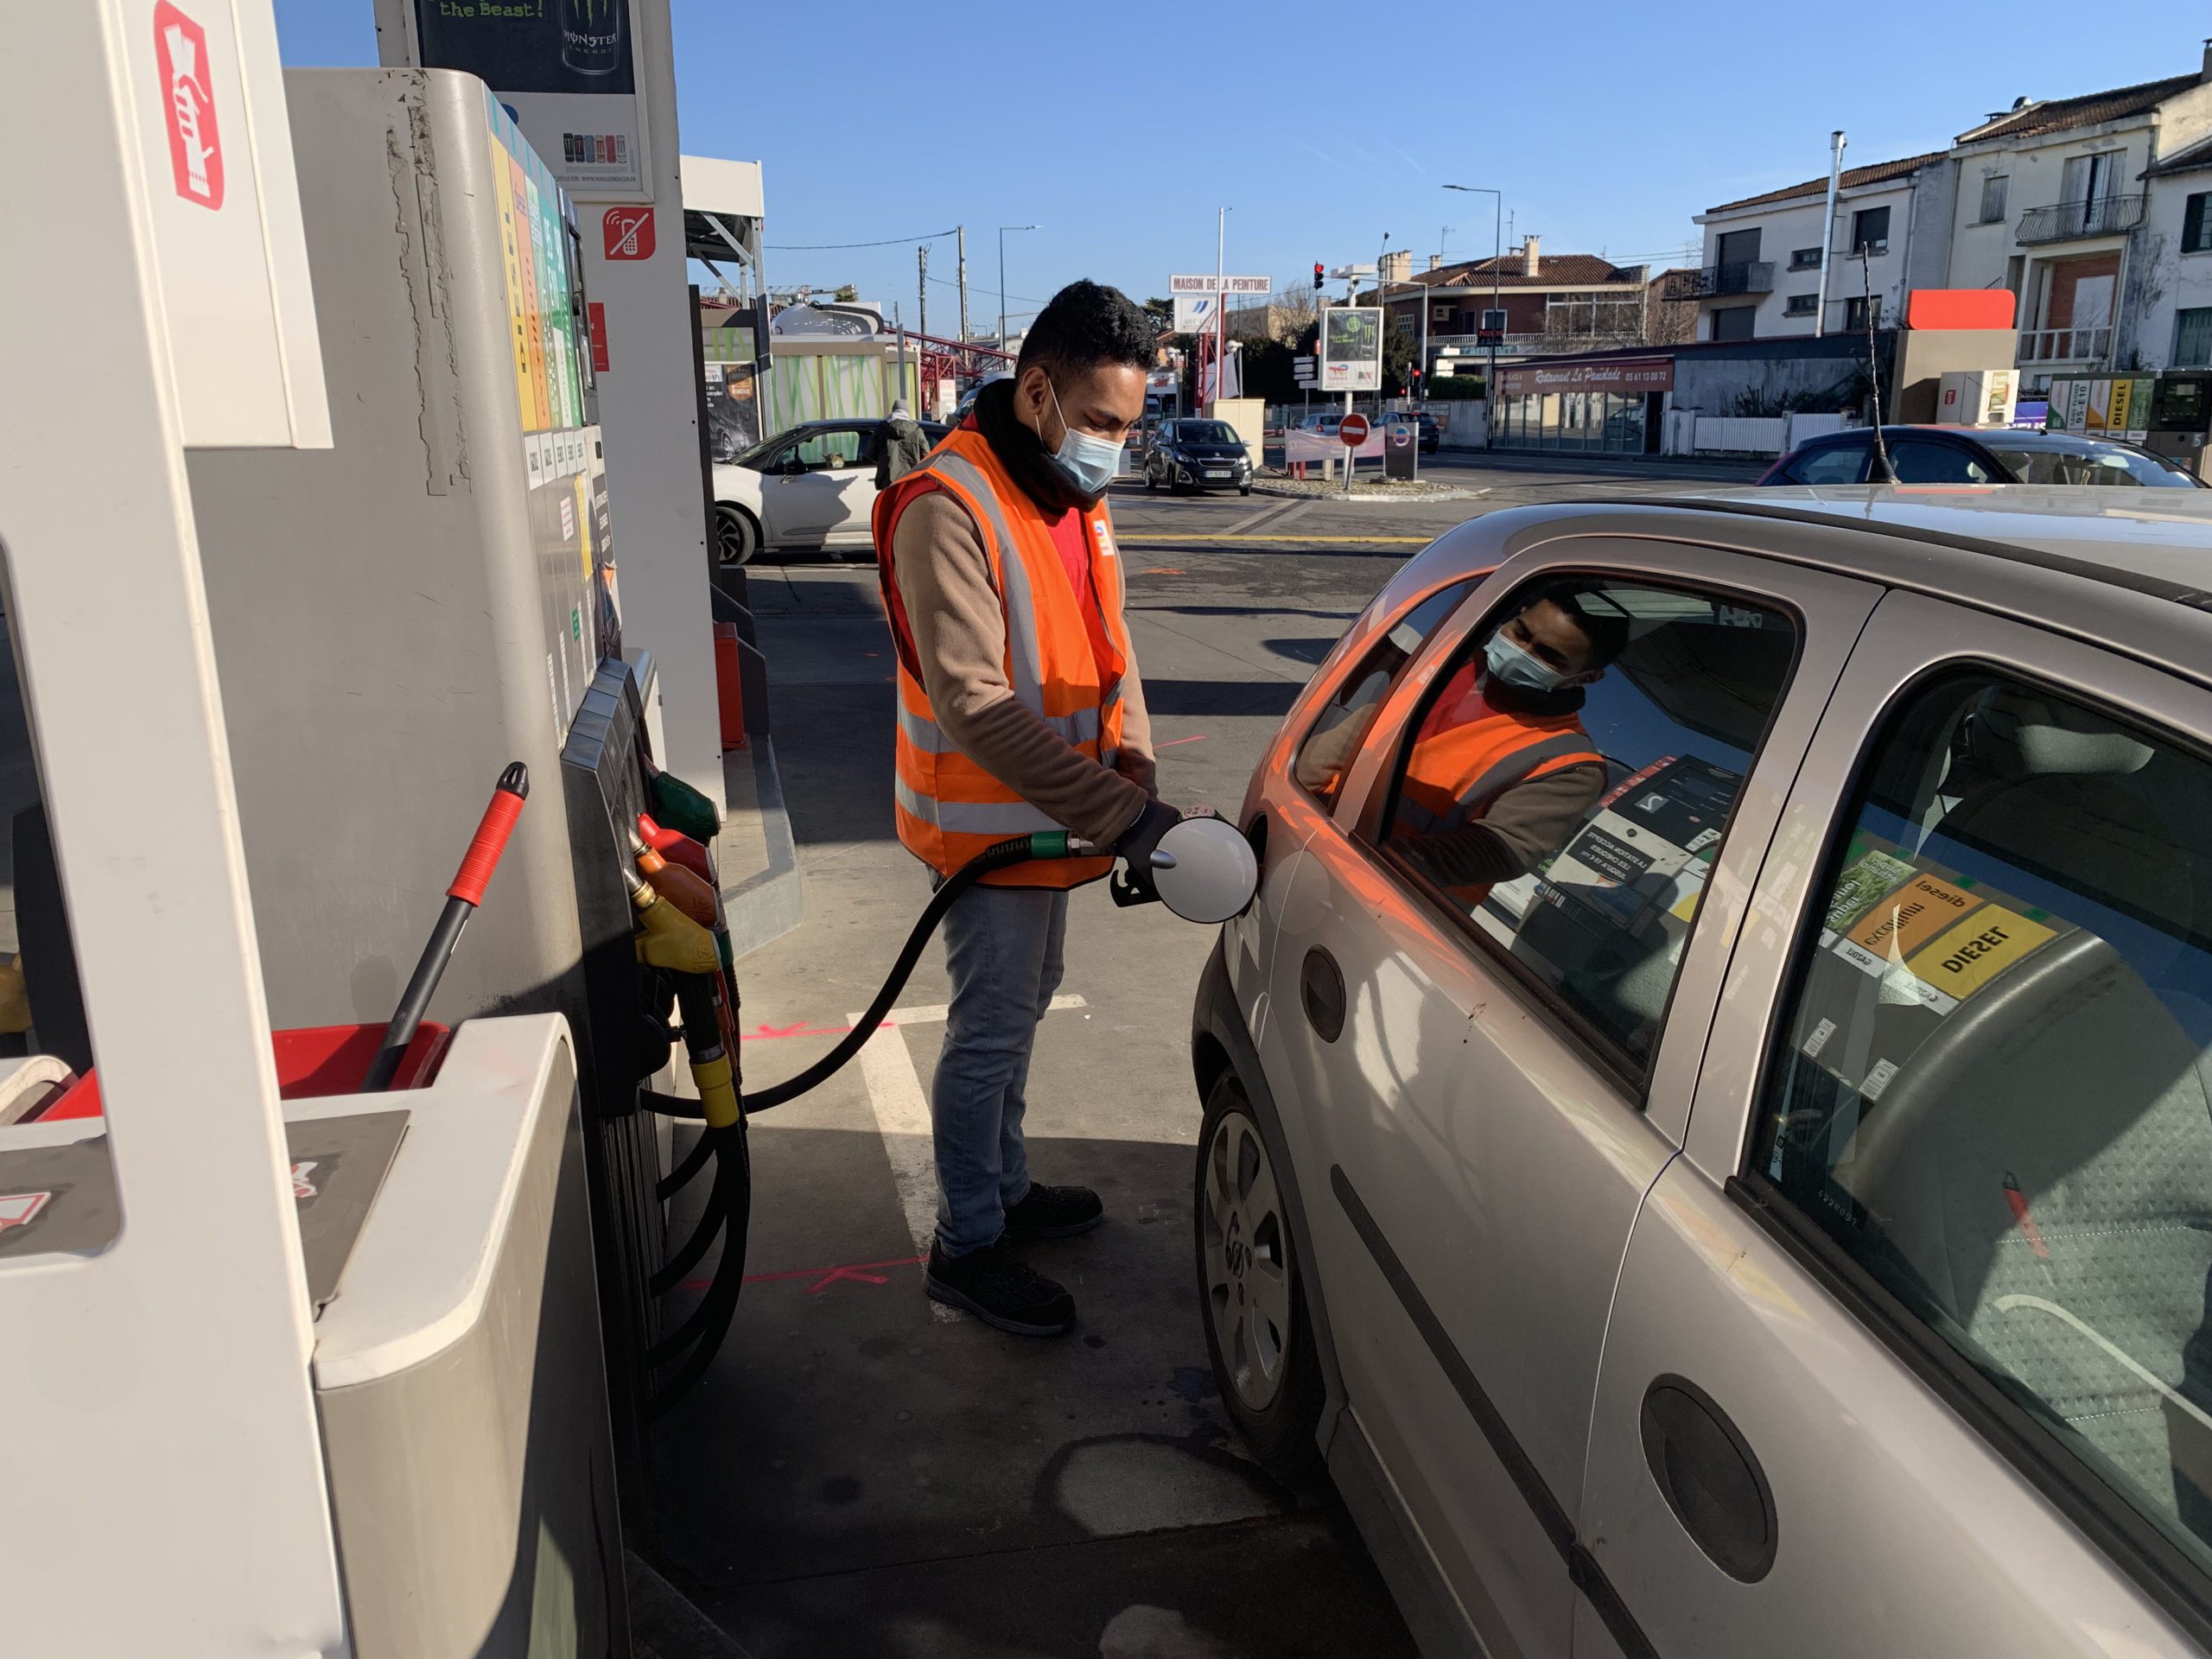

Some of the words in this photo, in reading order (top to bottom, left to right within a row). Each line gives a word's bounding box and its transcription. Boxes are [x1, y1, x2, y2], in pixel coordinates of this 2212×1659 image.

[440, 2, 474, 17] the
[479, 0, 543, 18] Beast!
[563, 29, 617, 48] MONSTER
[1173, 277, 1204, 290] MAISON
[1206, 278, 1217, 290] DE
[1232, 278, 1268, 290] PEINTURE
[1154, 375, 1169, 387] air
[1535, 369, 1571, 385] Restaurant
[1571, 367, 1583, 382] La
[1634, 372, 1642, 381] 61
[1650, 372, 1658, 380] 00
[1659, 372, 1667, 380] 72
[2113, 384, 2126, 425] DIESEL
[2192, 435, 2202, 447] 5
